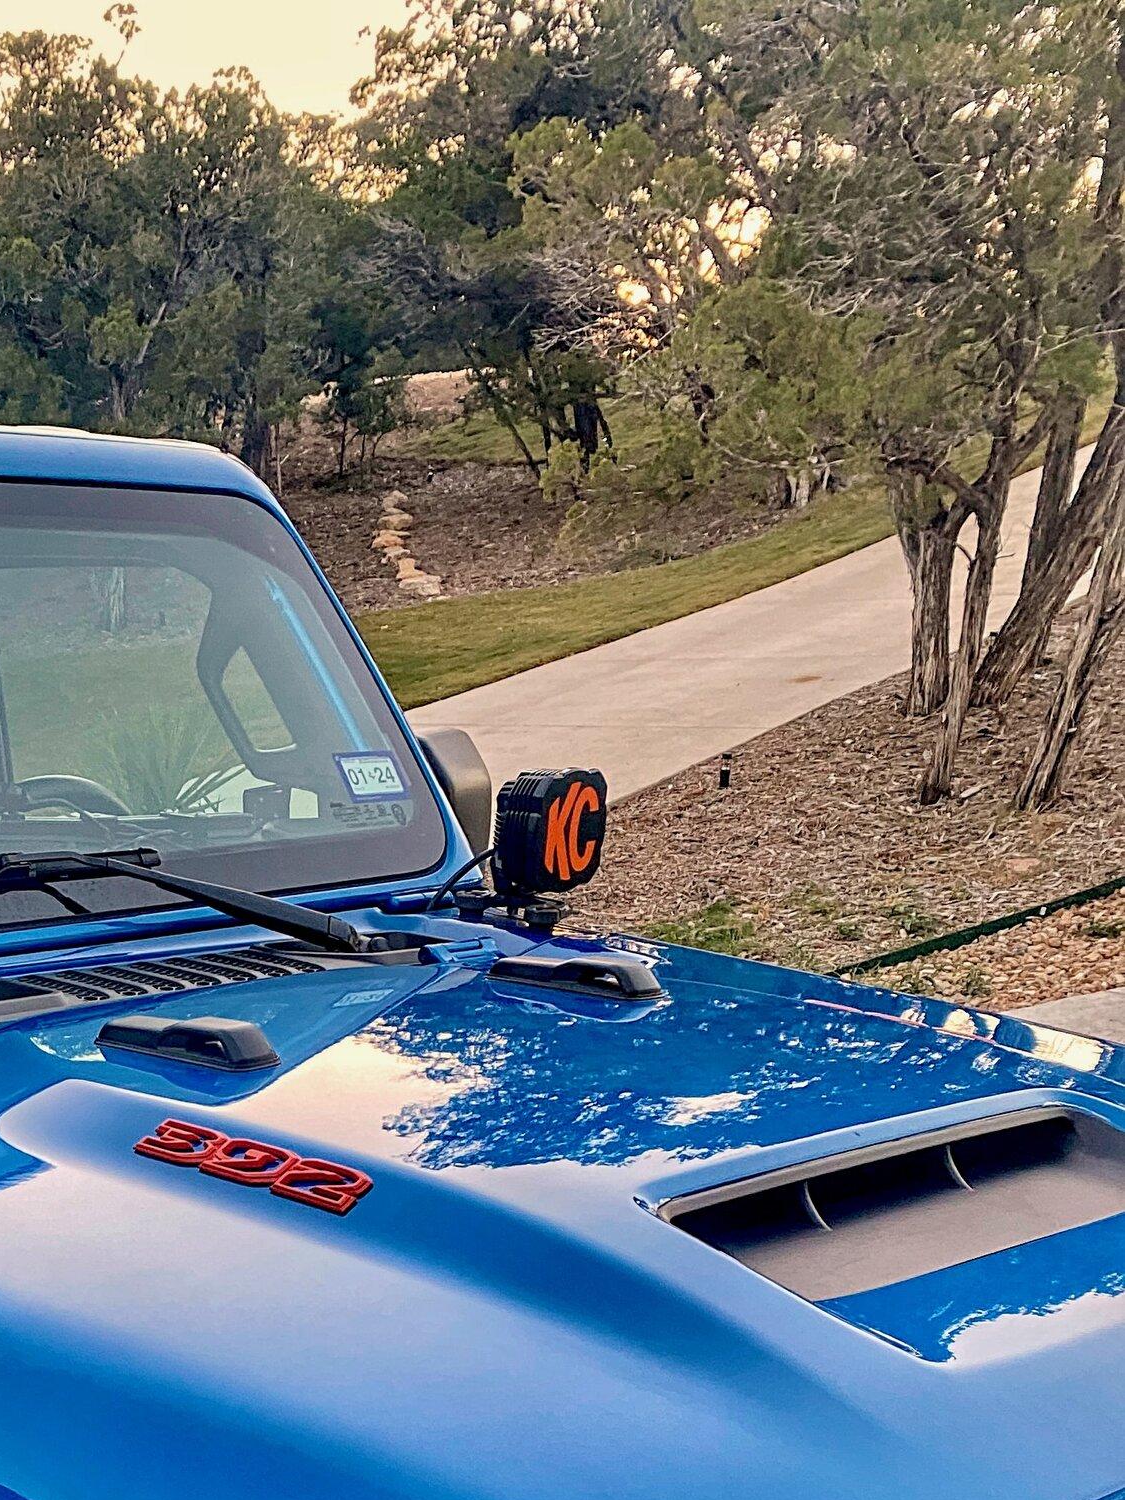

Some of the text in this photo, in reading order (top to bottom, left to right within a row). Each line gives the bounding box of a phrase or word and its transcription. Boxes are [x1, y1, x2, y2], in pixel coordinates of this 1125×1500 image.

[347, 766, 396, 786] 01 24
[544, 781, 600, 881] KC
[132, 1117, 374, 1216] 392
